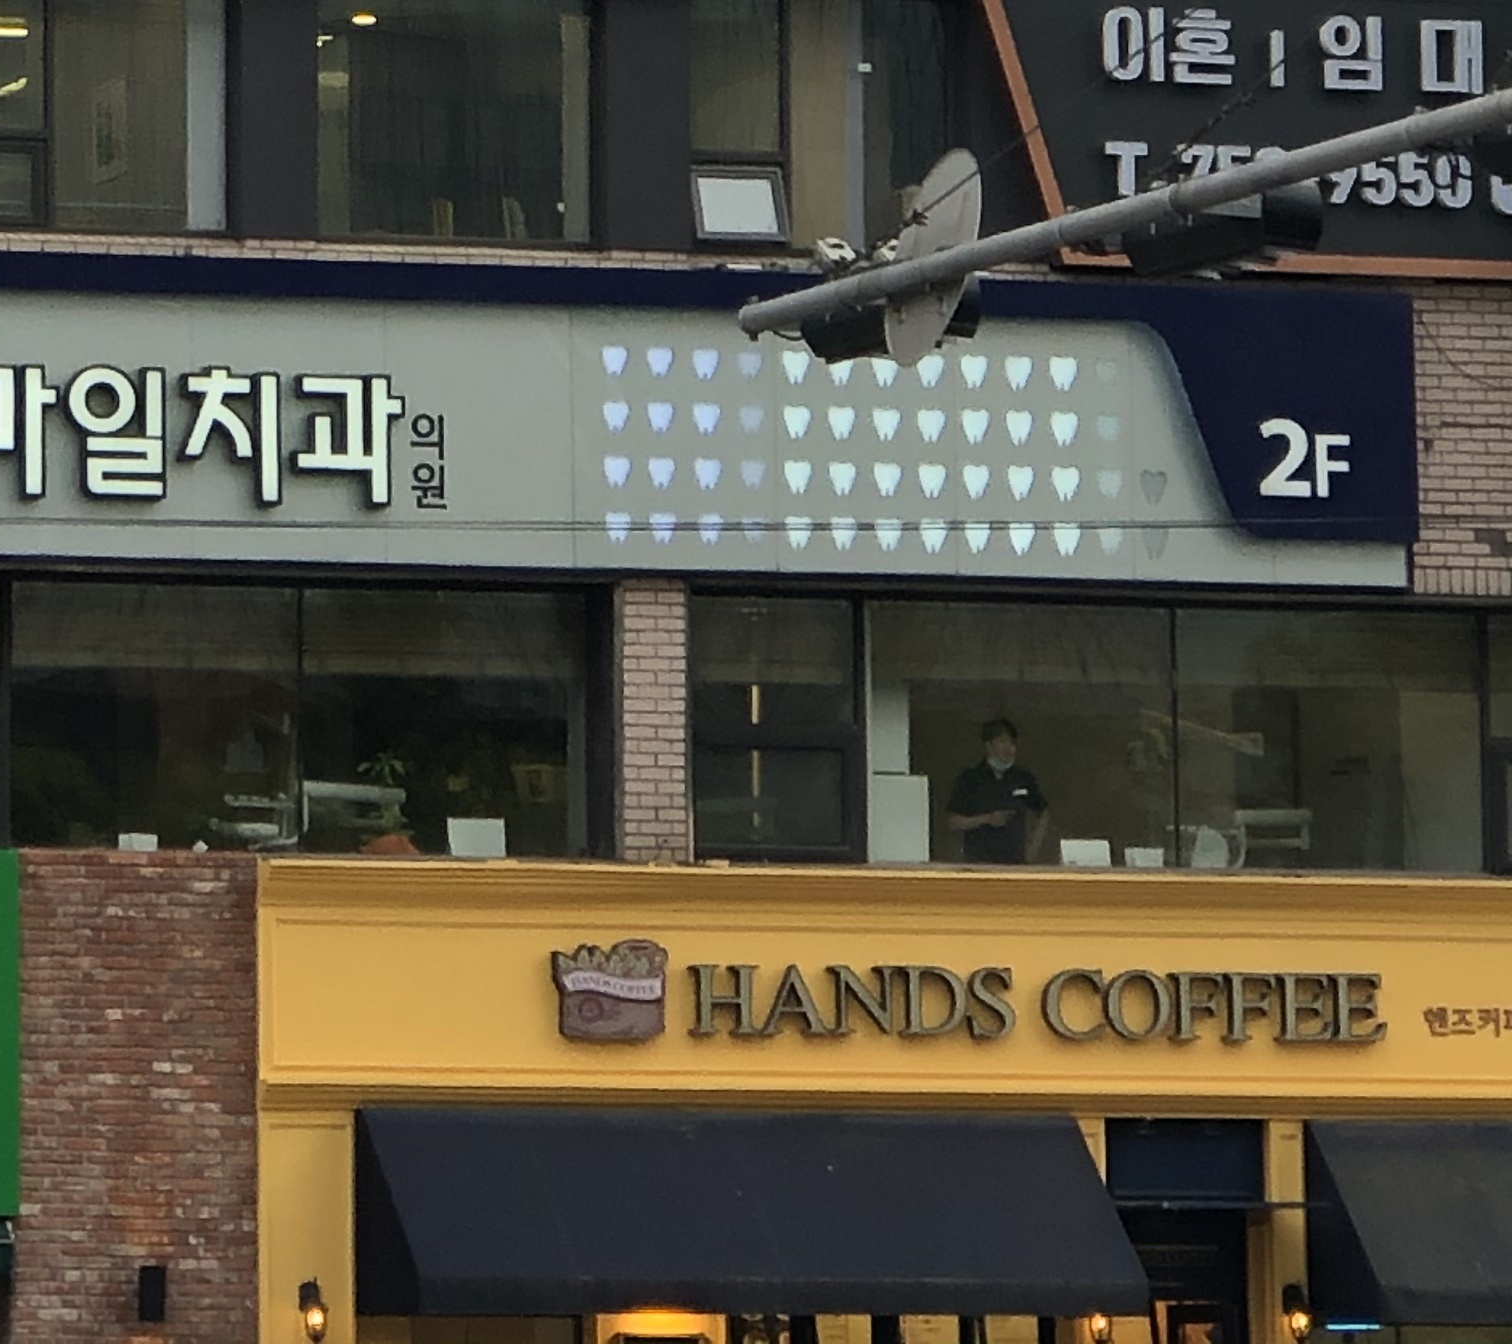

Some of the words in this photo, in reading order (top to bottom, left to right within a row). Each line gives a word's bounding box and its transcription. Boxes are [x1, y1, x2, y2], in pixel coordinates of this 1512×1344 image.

[1102, 5, 1237, 87] 이혼
[410, 412, 448, 510] 의원
[1258, 416, 1351, 498] 2F
[687, 962, 1019, 1042] HANDS
[1040, 968, 1389, 1045] COFFEE
